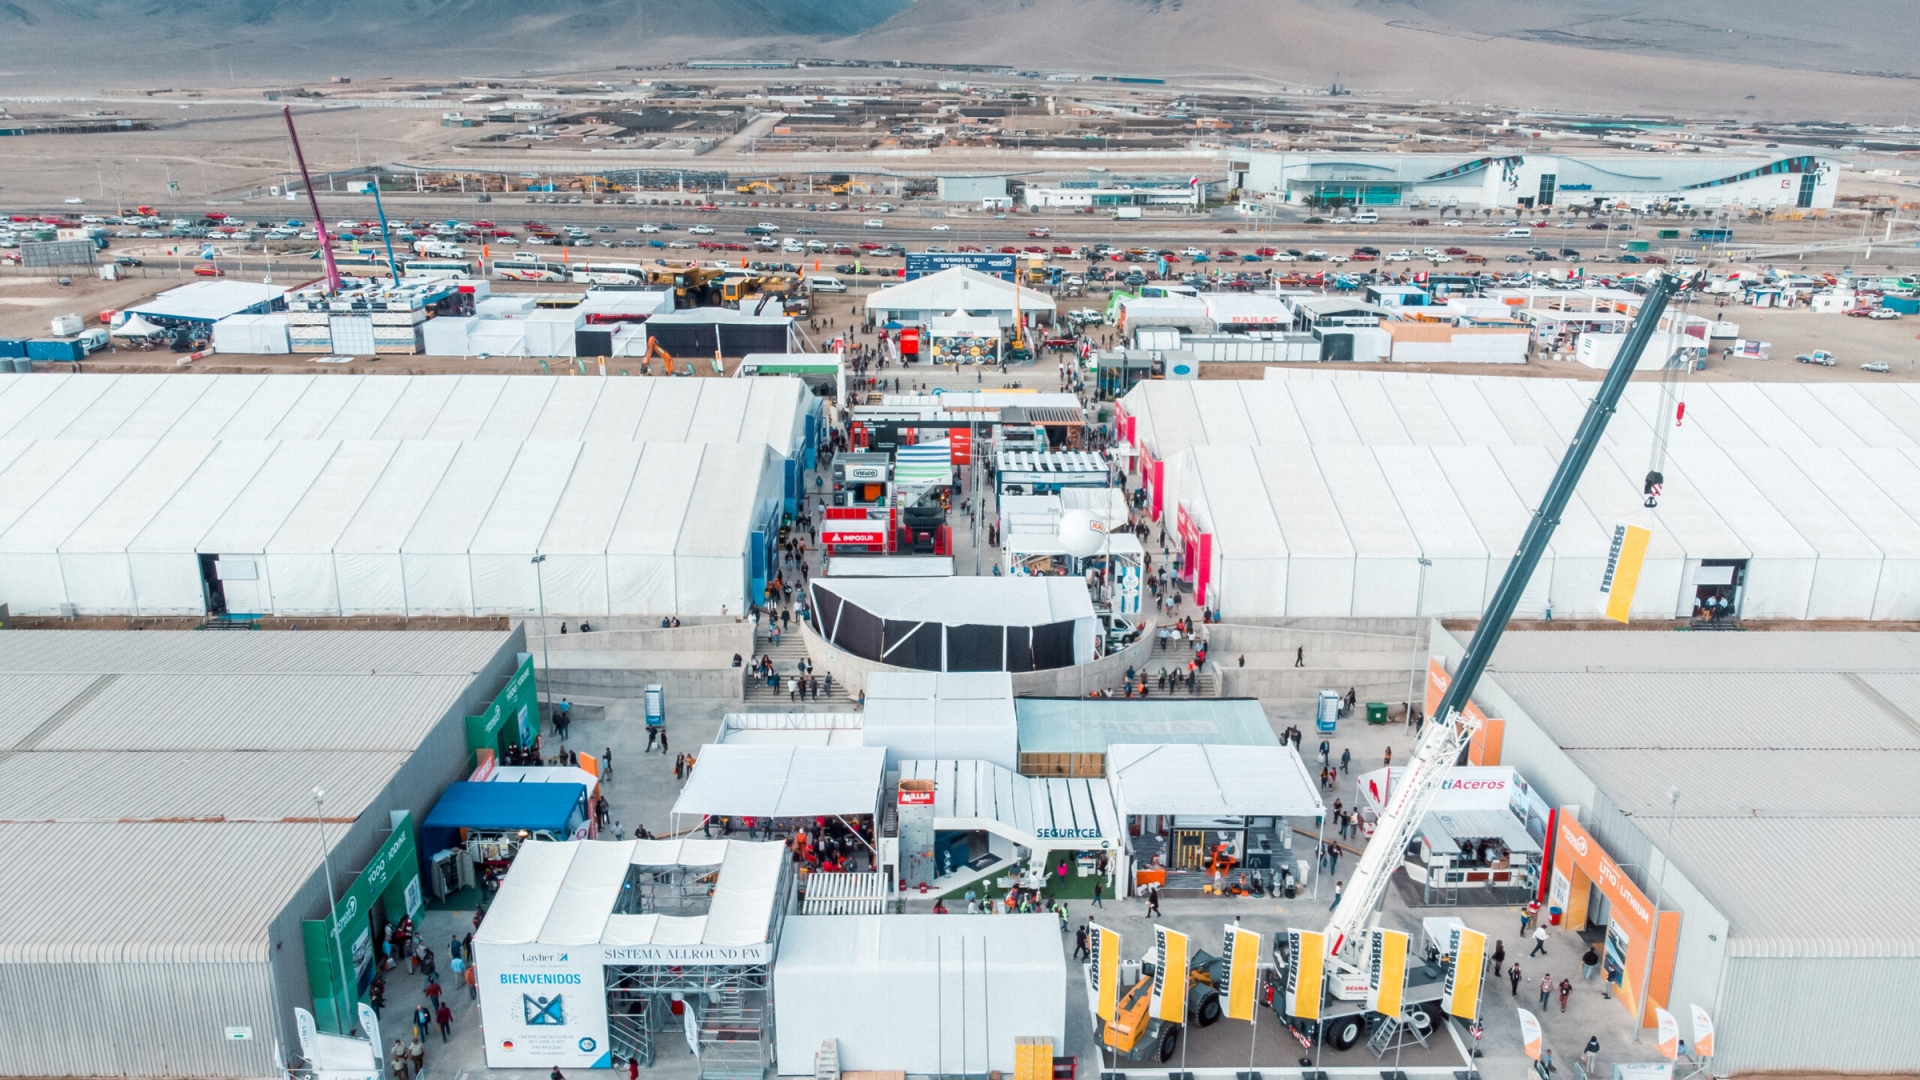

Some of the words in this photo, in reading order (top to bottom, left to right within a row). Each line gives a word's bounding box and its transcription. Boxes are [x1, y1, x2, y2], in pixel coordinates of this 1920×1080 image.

[1428, 779, 1505, 790] tiAceros
[902, 793, 930, 802] MILLER
[1037, 828, 1102, 838] SEGURYCEL
[368, 859, 385, 885] YODO
[388, 831, 407, 860] IODINE
[1599, 861, 1617, 886] LITIO
[1619, 884, 1649, 924] LITHIUM
[522, 953, 555, 962] Layher
[605, 949, 661, 959] SISTEMA
[666, 949, 737, 959] ALLROUND
[742, 949, 763, 959] FW
[500, 973, 581, 985] BIENVENIDOS
